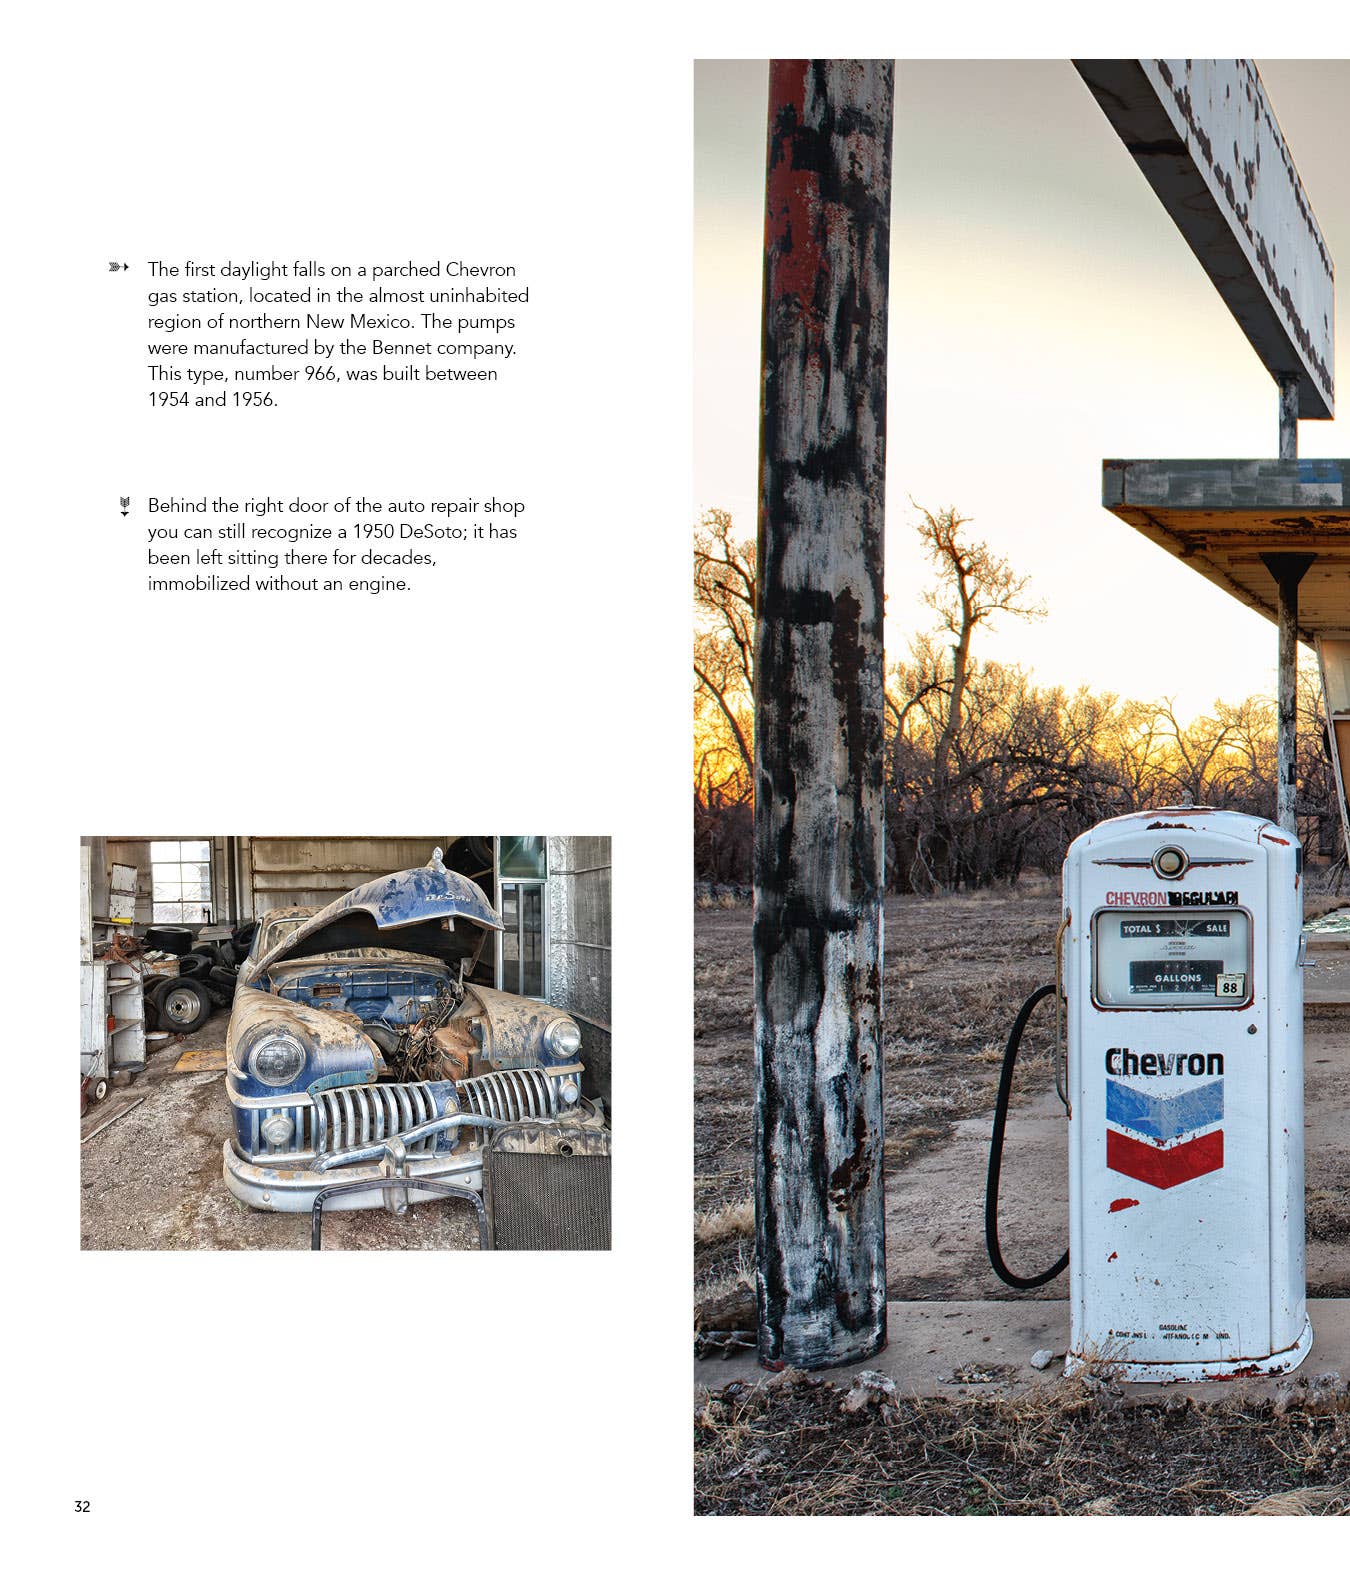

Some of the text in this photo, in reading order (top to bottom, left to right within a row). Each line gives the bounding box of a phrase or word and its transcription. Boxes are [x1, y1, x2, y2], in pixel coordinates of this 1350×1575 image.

[1105, 891, 1167, 906] CHEVRON
[1123, 925, 1152, 933] TOTAL
[1207, 924, 1228, 933] SALE
[1155, 974, 1202, 983] GALLONS
[1223, 983, 1237, 993] 88
[1105, 1047, 1225, 1076] Chevron
